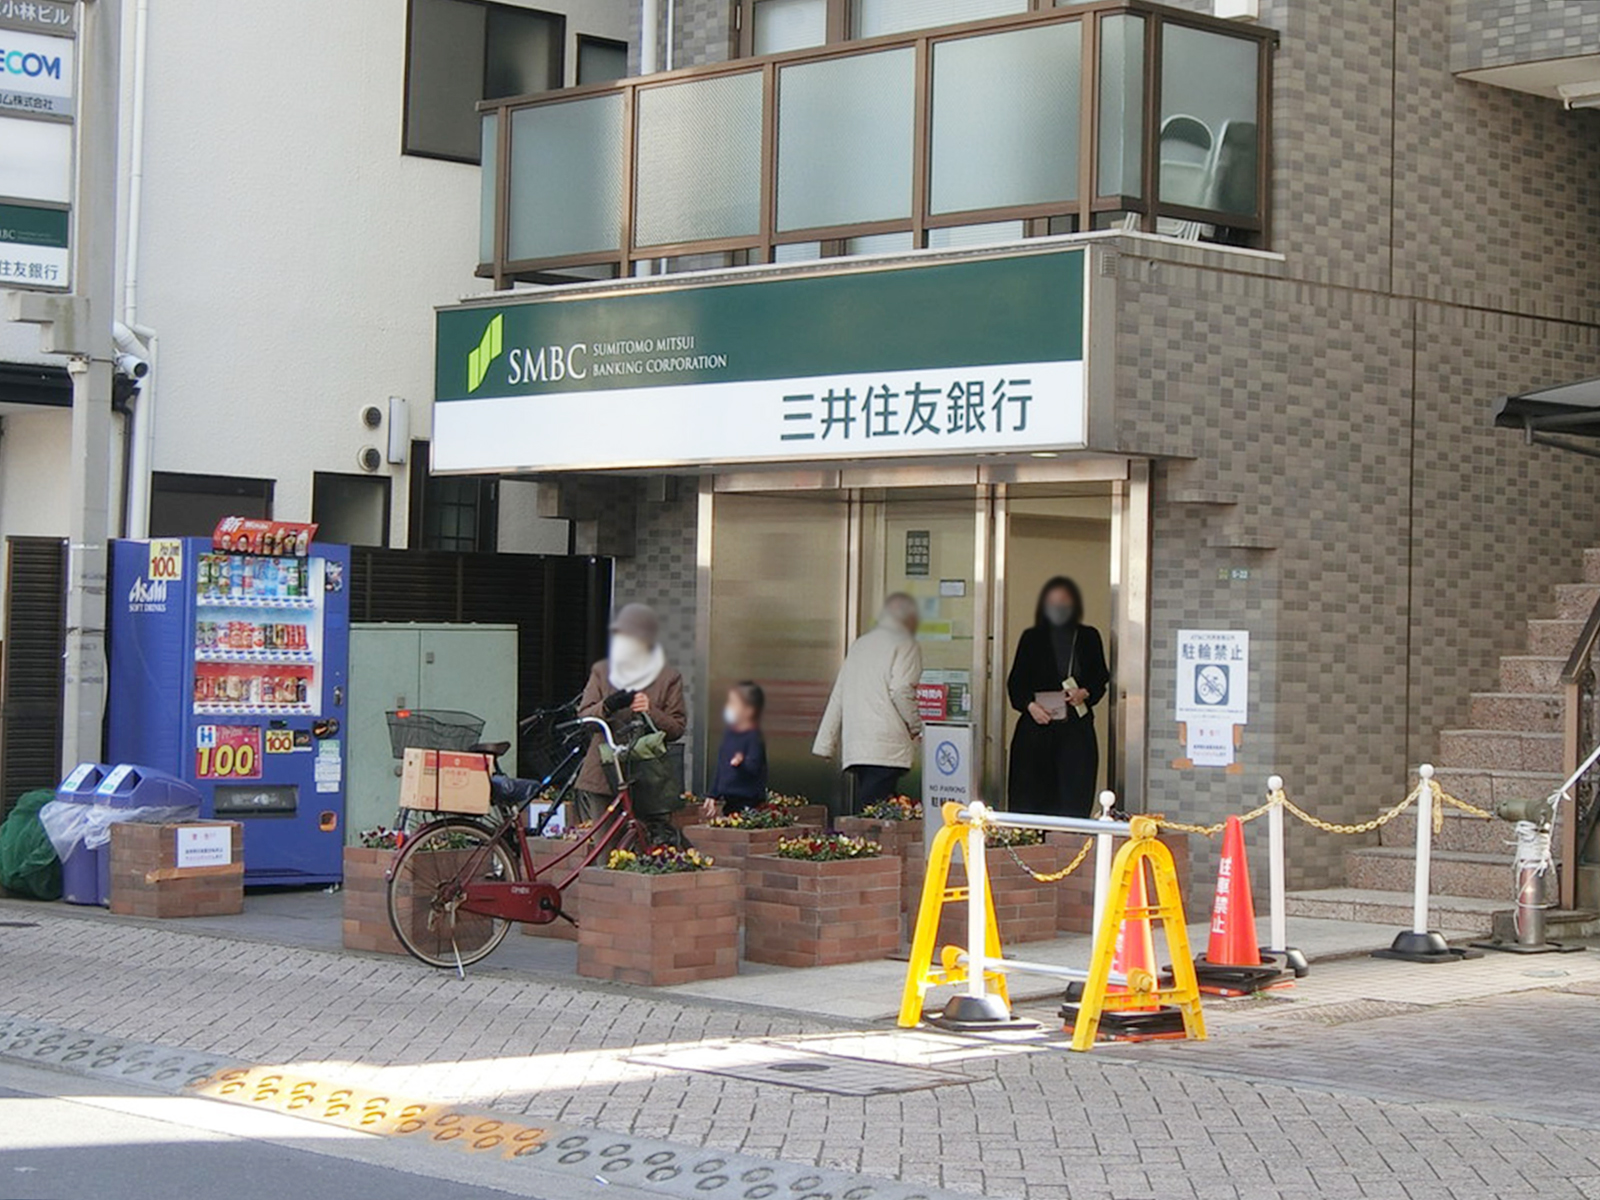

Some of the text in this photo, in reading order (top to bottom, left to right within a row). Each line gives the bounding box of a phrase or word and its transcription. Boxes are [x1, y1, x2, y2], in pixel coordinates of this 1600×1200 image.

[0, 0, 71, 25] 小林ビル
[0, 94, 54, 110] ム株式会社
[0, 229, 16, 240] BC
[593, 336, 695, 357] SUMITOMO MITSUI
[508, 344, 587, 384] SMBC
[593, 354, 728, 377] BANKING CORPORATION
[780, 378, 1033, 441] 三井住友銀行
[129, 576, 167, 603] Asahi
[1182, 643, 1243, 661] 駐輪禁止
[267, 736, 292, 751] 100
[198, 744, 255, 776] 100
[929, 784, 938, 792] NO
